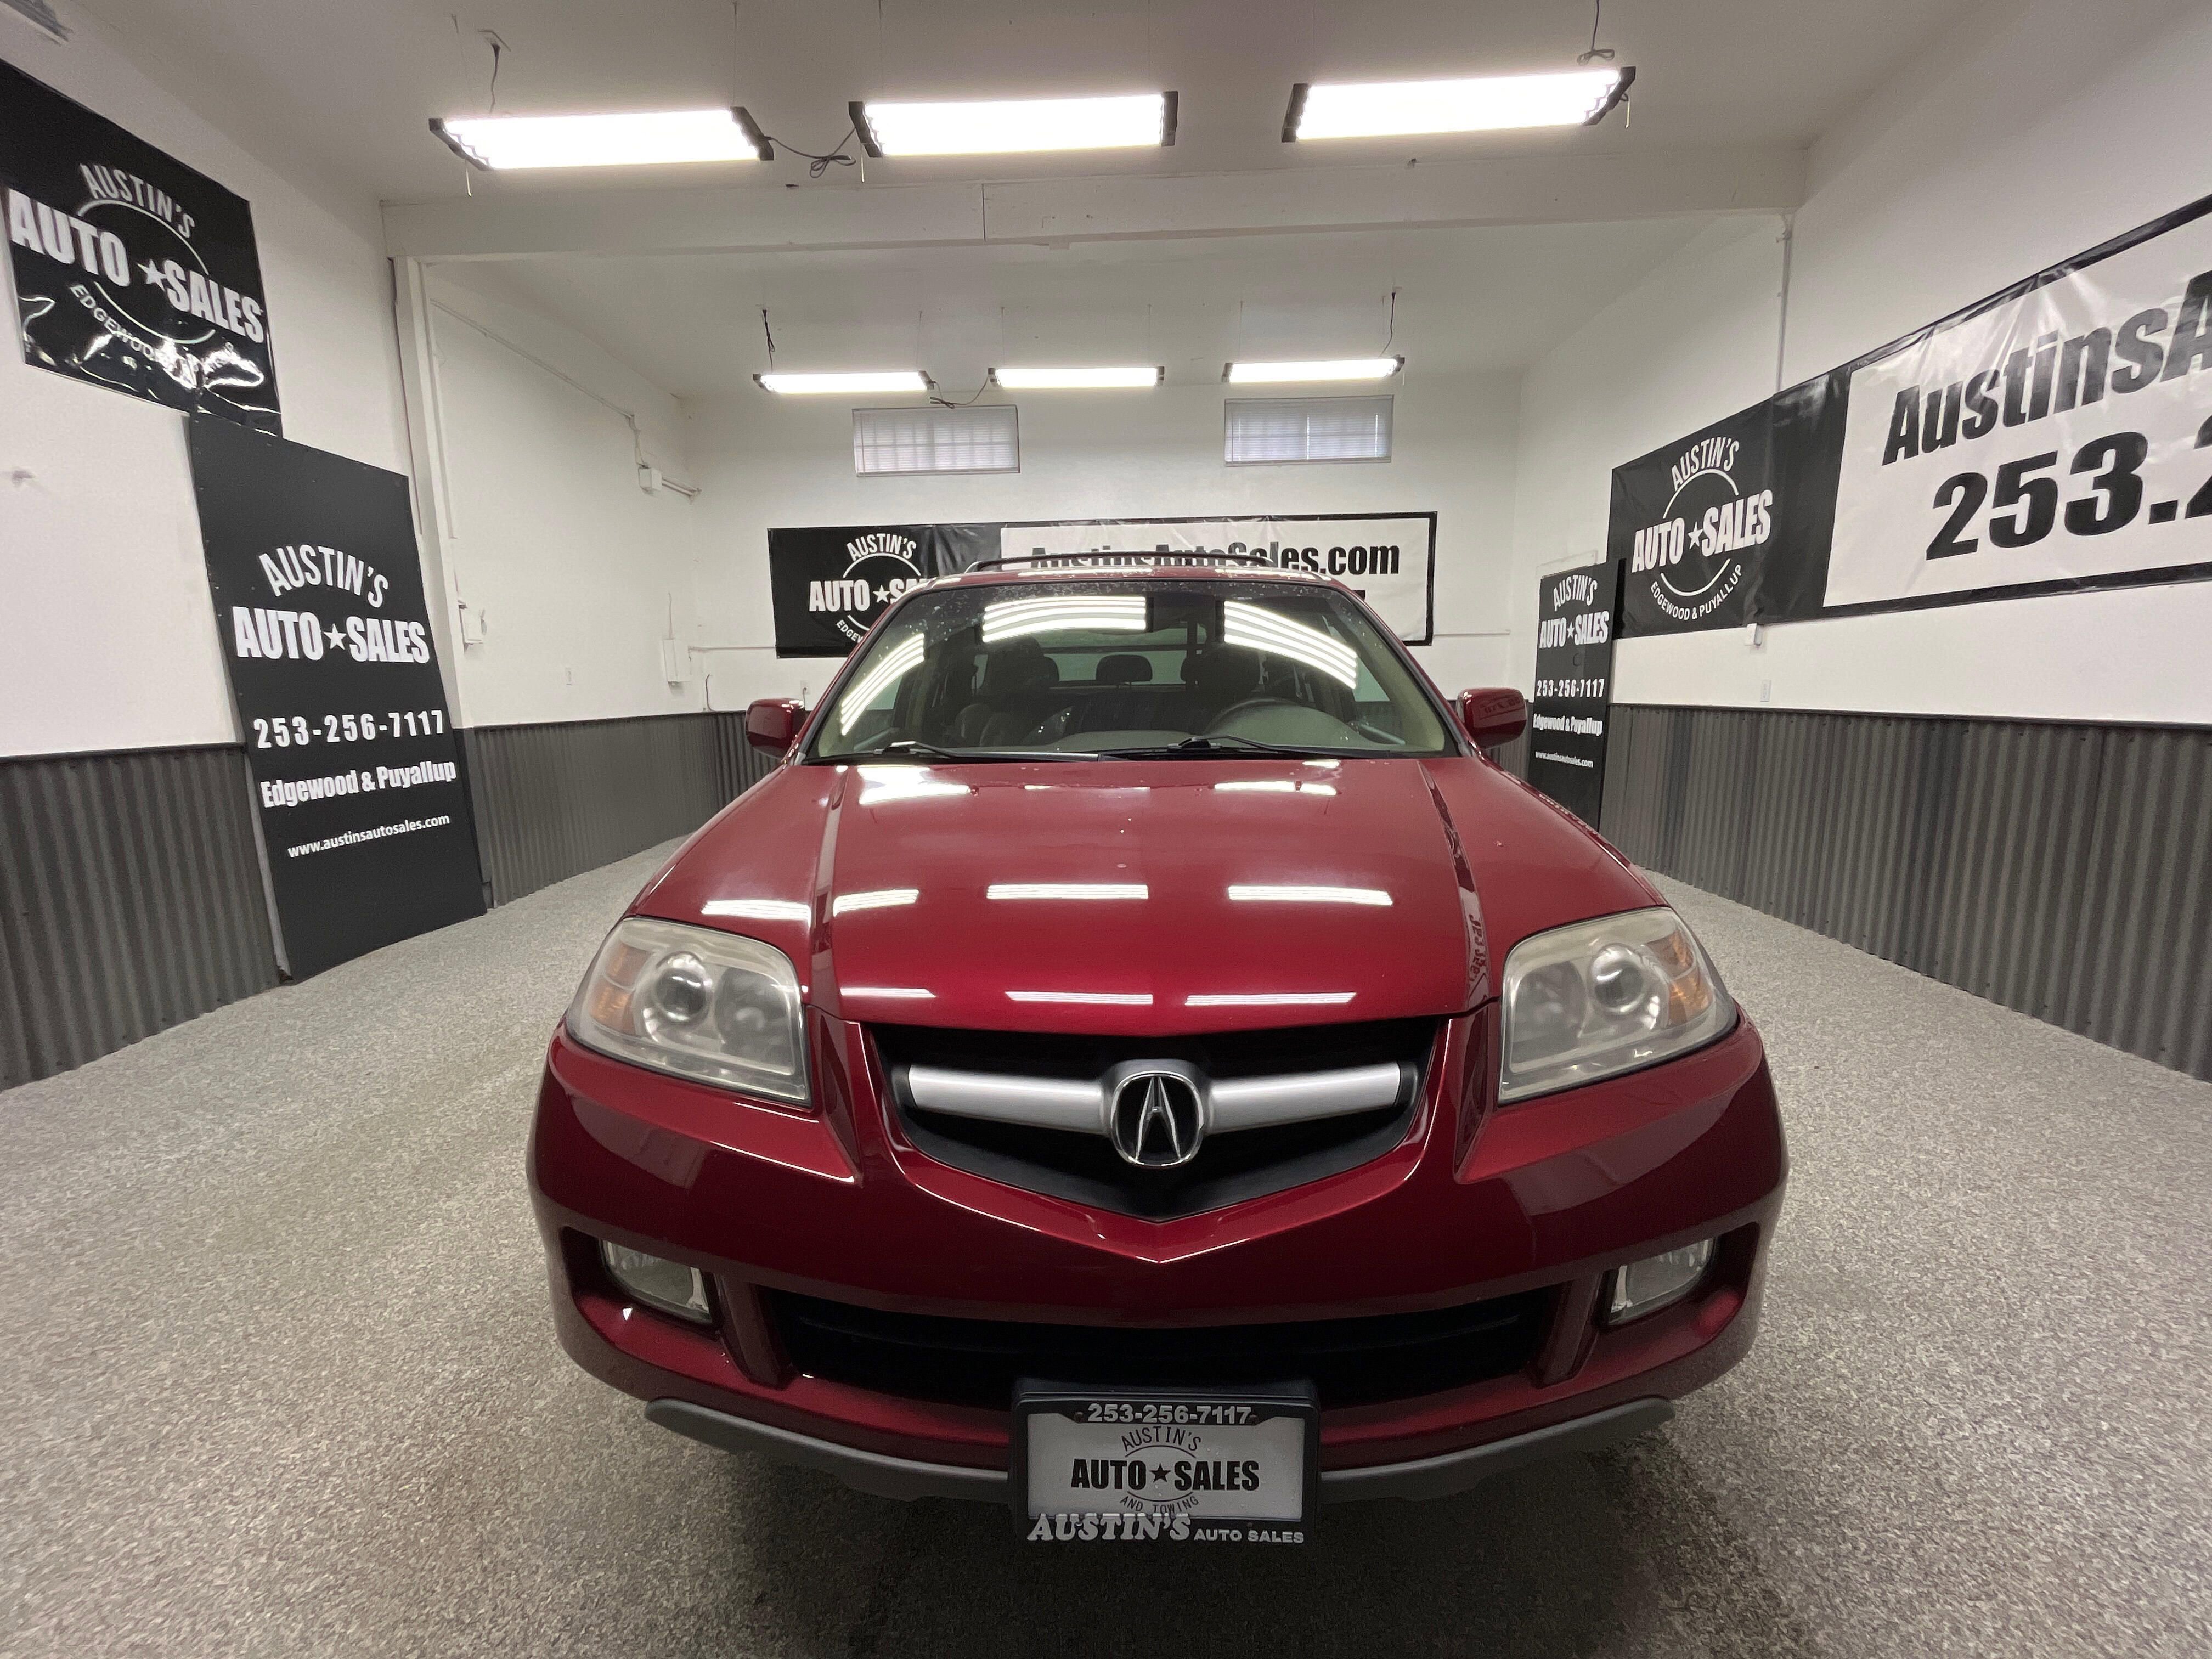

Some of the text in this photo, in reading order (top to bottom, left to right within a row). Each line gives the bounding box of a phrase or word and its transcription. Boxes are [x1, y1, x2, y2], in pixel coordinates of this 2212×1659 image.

[78, 162, 196, 239] AUSTIN'S
[8, 188, 264, 343] AUTO SALES
[1671, 437, 1739, 492] AUSTIN'S
[847, 534, 917, 562] AUSTIN'S
[1632, 489, 1773, 573] AUTO SALES
[259, 543, 388, 608] AUSTIN'S
[1553, 574, 1598, 611] AUSTIN'S
[1650, 564, 1742, 621] EDGEWOOD & PUYALLUP
[809, 579, 870, 612] AUTO
[232, 606, 430, 664] AUTO SALES
[1539, 610, 1609, 648] AUTO SALES
[253, 709, 444, 748] 253-256-7117
[260, 761, 456, 808] Edgewood & Puyallup
[288, 816, 450, 857] www.austinsautosales.com
[1087, 1403, 1251, 1424] 253-256-7117
[1121, 1426, 1201, 1452] AUSTIN'S
[1071, 1458, 1260, 1491] AUTO SALES
[1120, 1495, 1199, 1514] AND TOWING
[1027, 1513, 1190, 1541] AUSTIN'S
[1194, 1529, 1304, 1544] AUTO SALES
